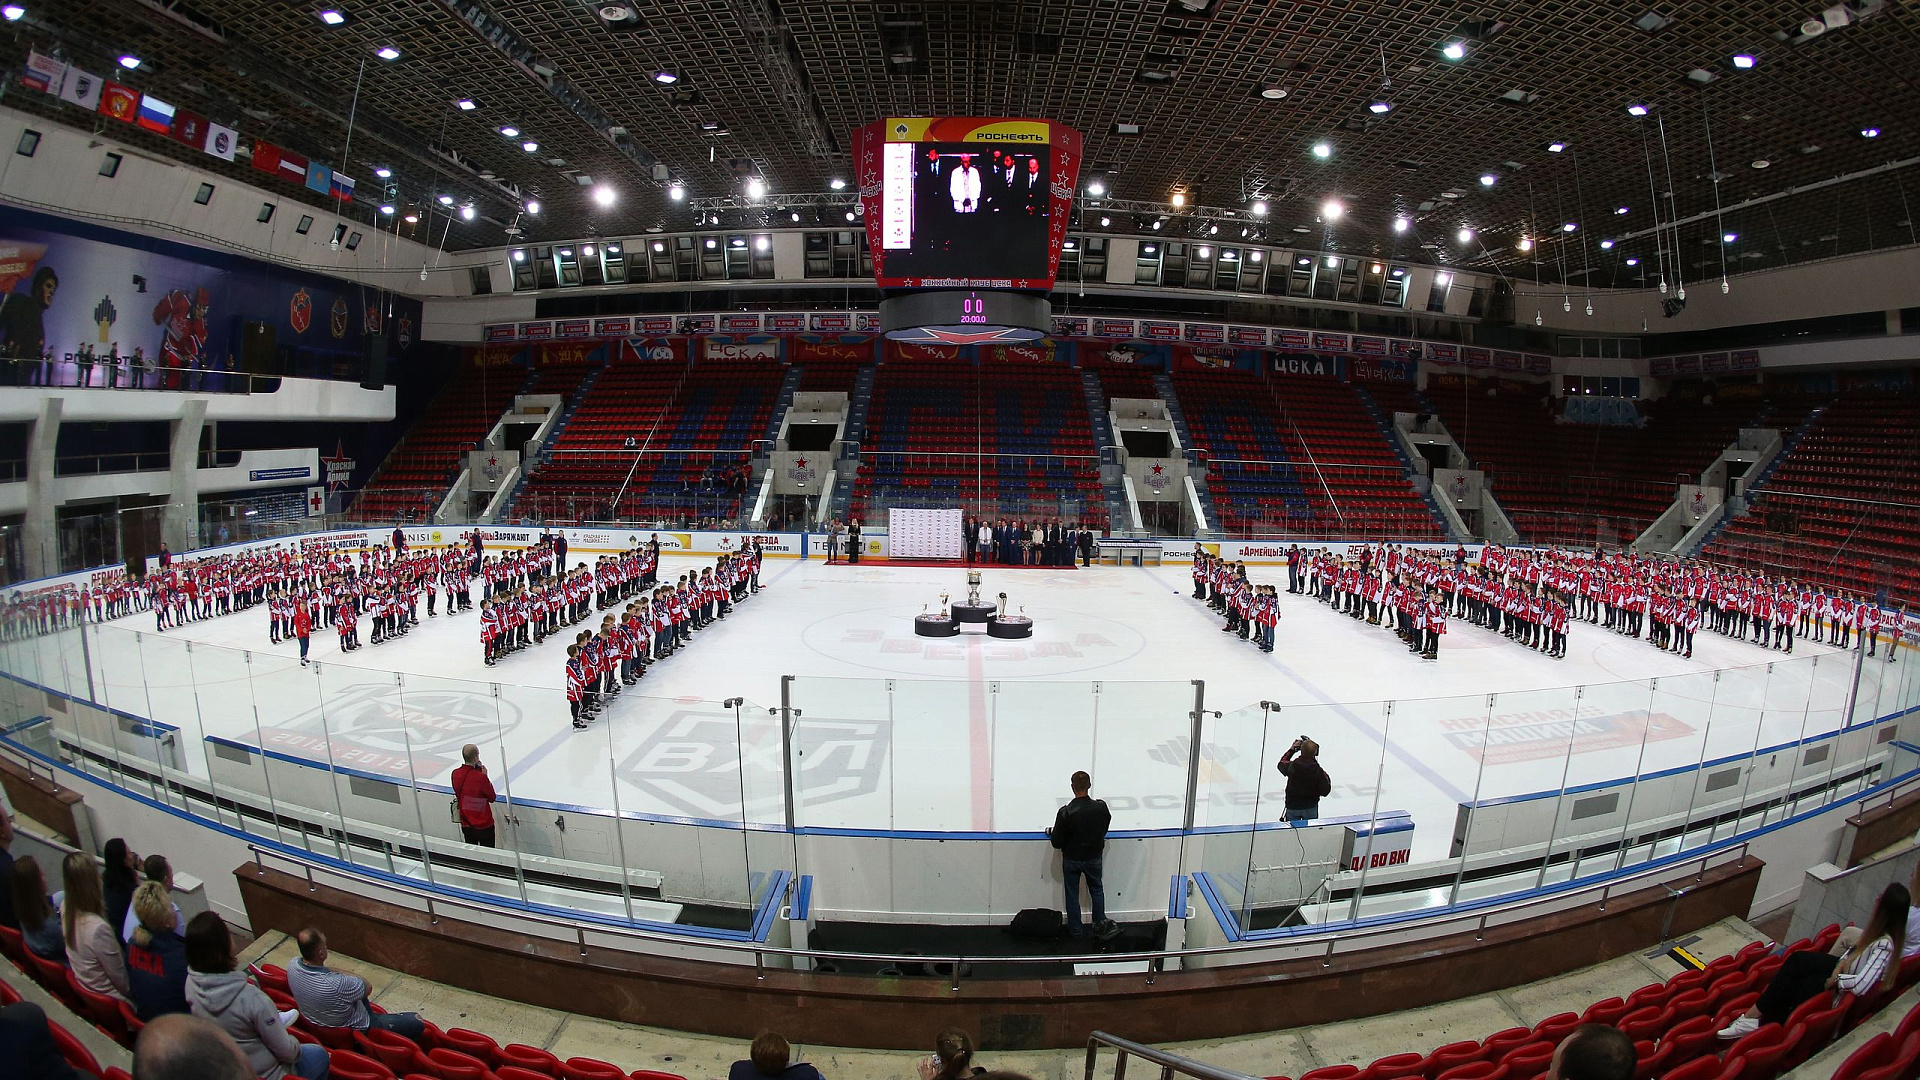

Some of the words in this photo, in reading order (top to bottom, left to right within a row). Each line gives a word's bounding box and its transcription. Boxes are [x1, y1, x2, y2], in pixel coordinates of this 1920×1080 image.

[976, 132, 1043, 141] РОСНЕФТЬ
[1050, 182, 1073, 200] ЦСКА
[920, 278, 969, 289] ХОККЕЙНЫЙ
[969, 279, 989, 288] КЛУБ
[990, 279, 1012, 288] ЦСКА
[963, 299, 970, 313] 0
[975, 299, 983, 313] 0
[960, 316, 986, 324] 20:00.0
[804, 344, 859, 360] ЦСКА
[1274, 359, 1326, 376] ЦСКА
[327, 460, 357, 472] Красная
[327, 472, 351, 483] Армия
[1438, 709, 1568, 731] КРАСНАЯ
[1455, 720, 1606, 748] МАШИНА
[633, 737, 874, 775] ВХЛ
